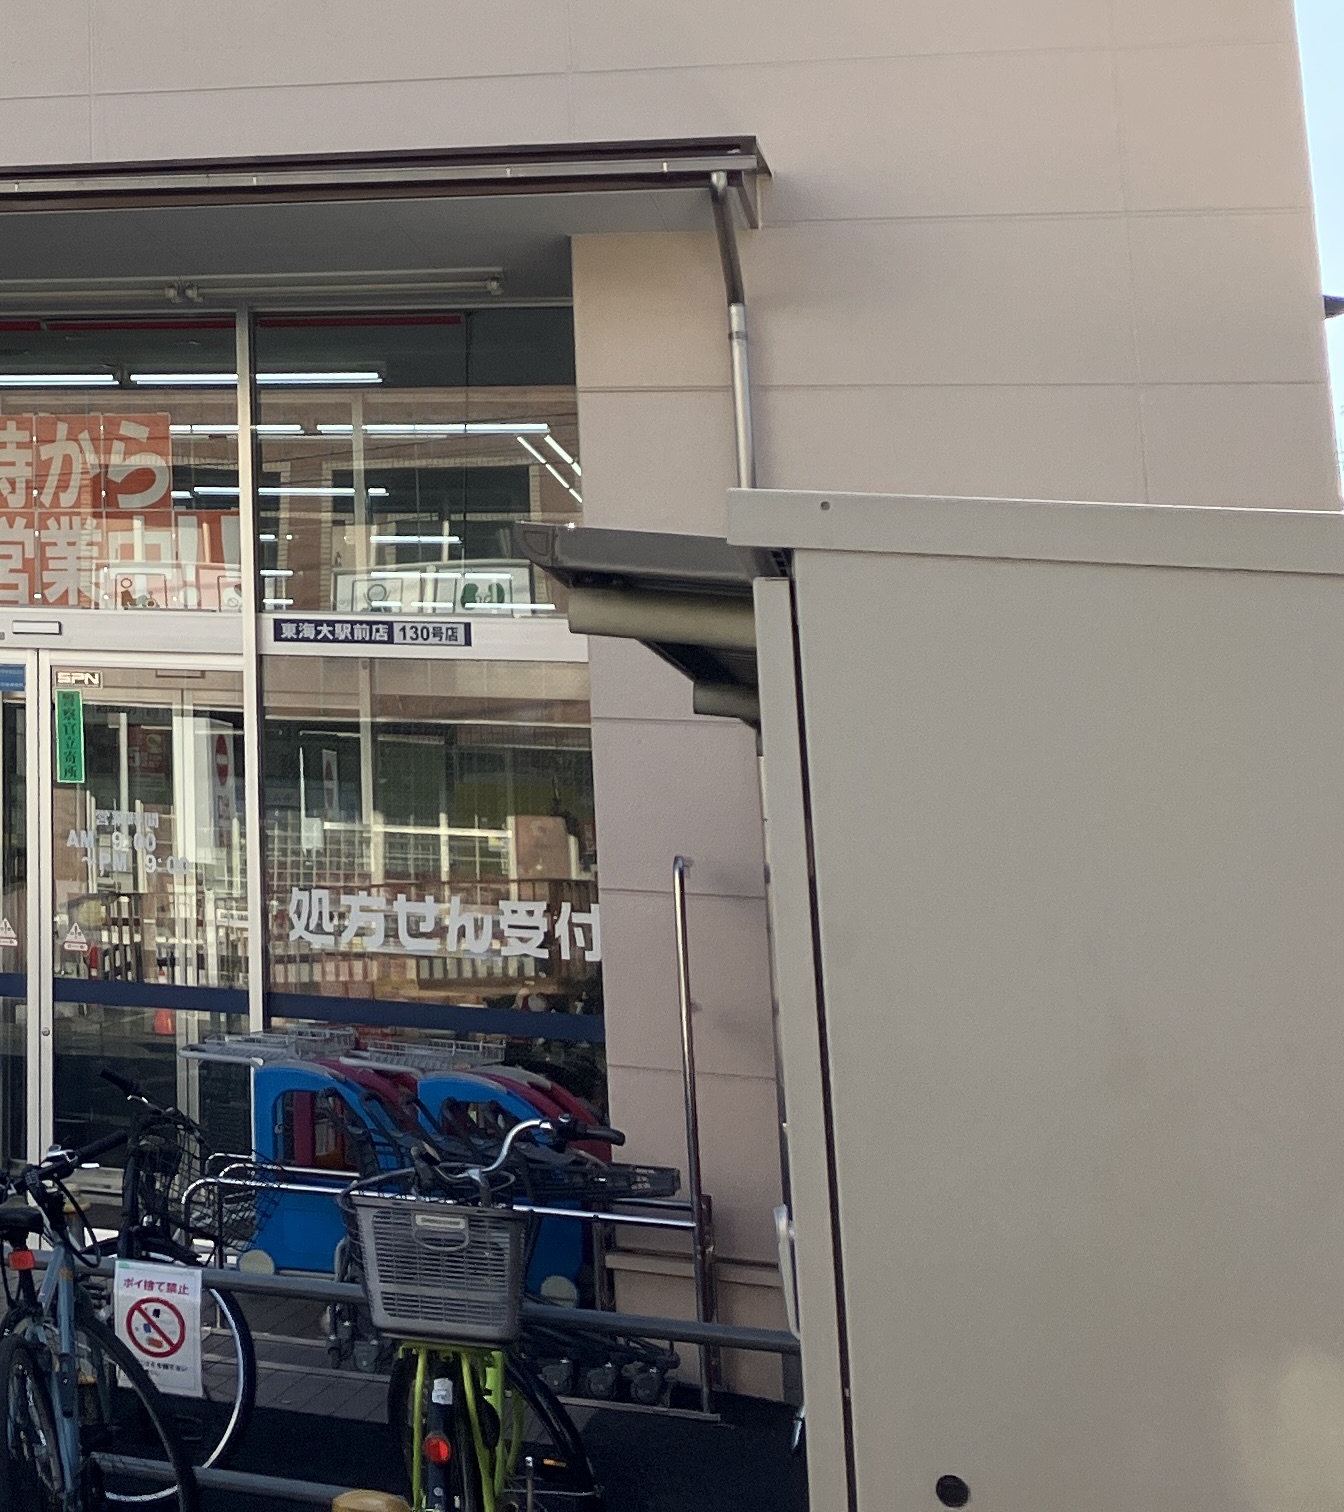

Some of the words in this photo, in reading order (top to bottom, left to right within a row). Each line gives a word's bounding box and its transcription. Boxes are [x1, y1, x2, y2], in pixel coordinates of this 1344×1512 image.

[280, 622, 389, 641] 東海大駅前店
[399, 625, 459, 642] 130号店
[58, 673, 100, 685] SPN
[62, 692, 77, 779] 警察官立寄所
[67, 830, 96, 848] AM
[146, 854, 191, 874] 9:00
[289, 887, 603, 962] 処方せん受付
[123, 1278, 190, 1295] ポイ捨て禁止
